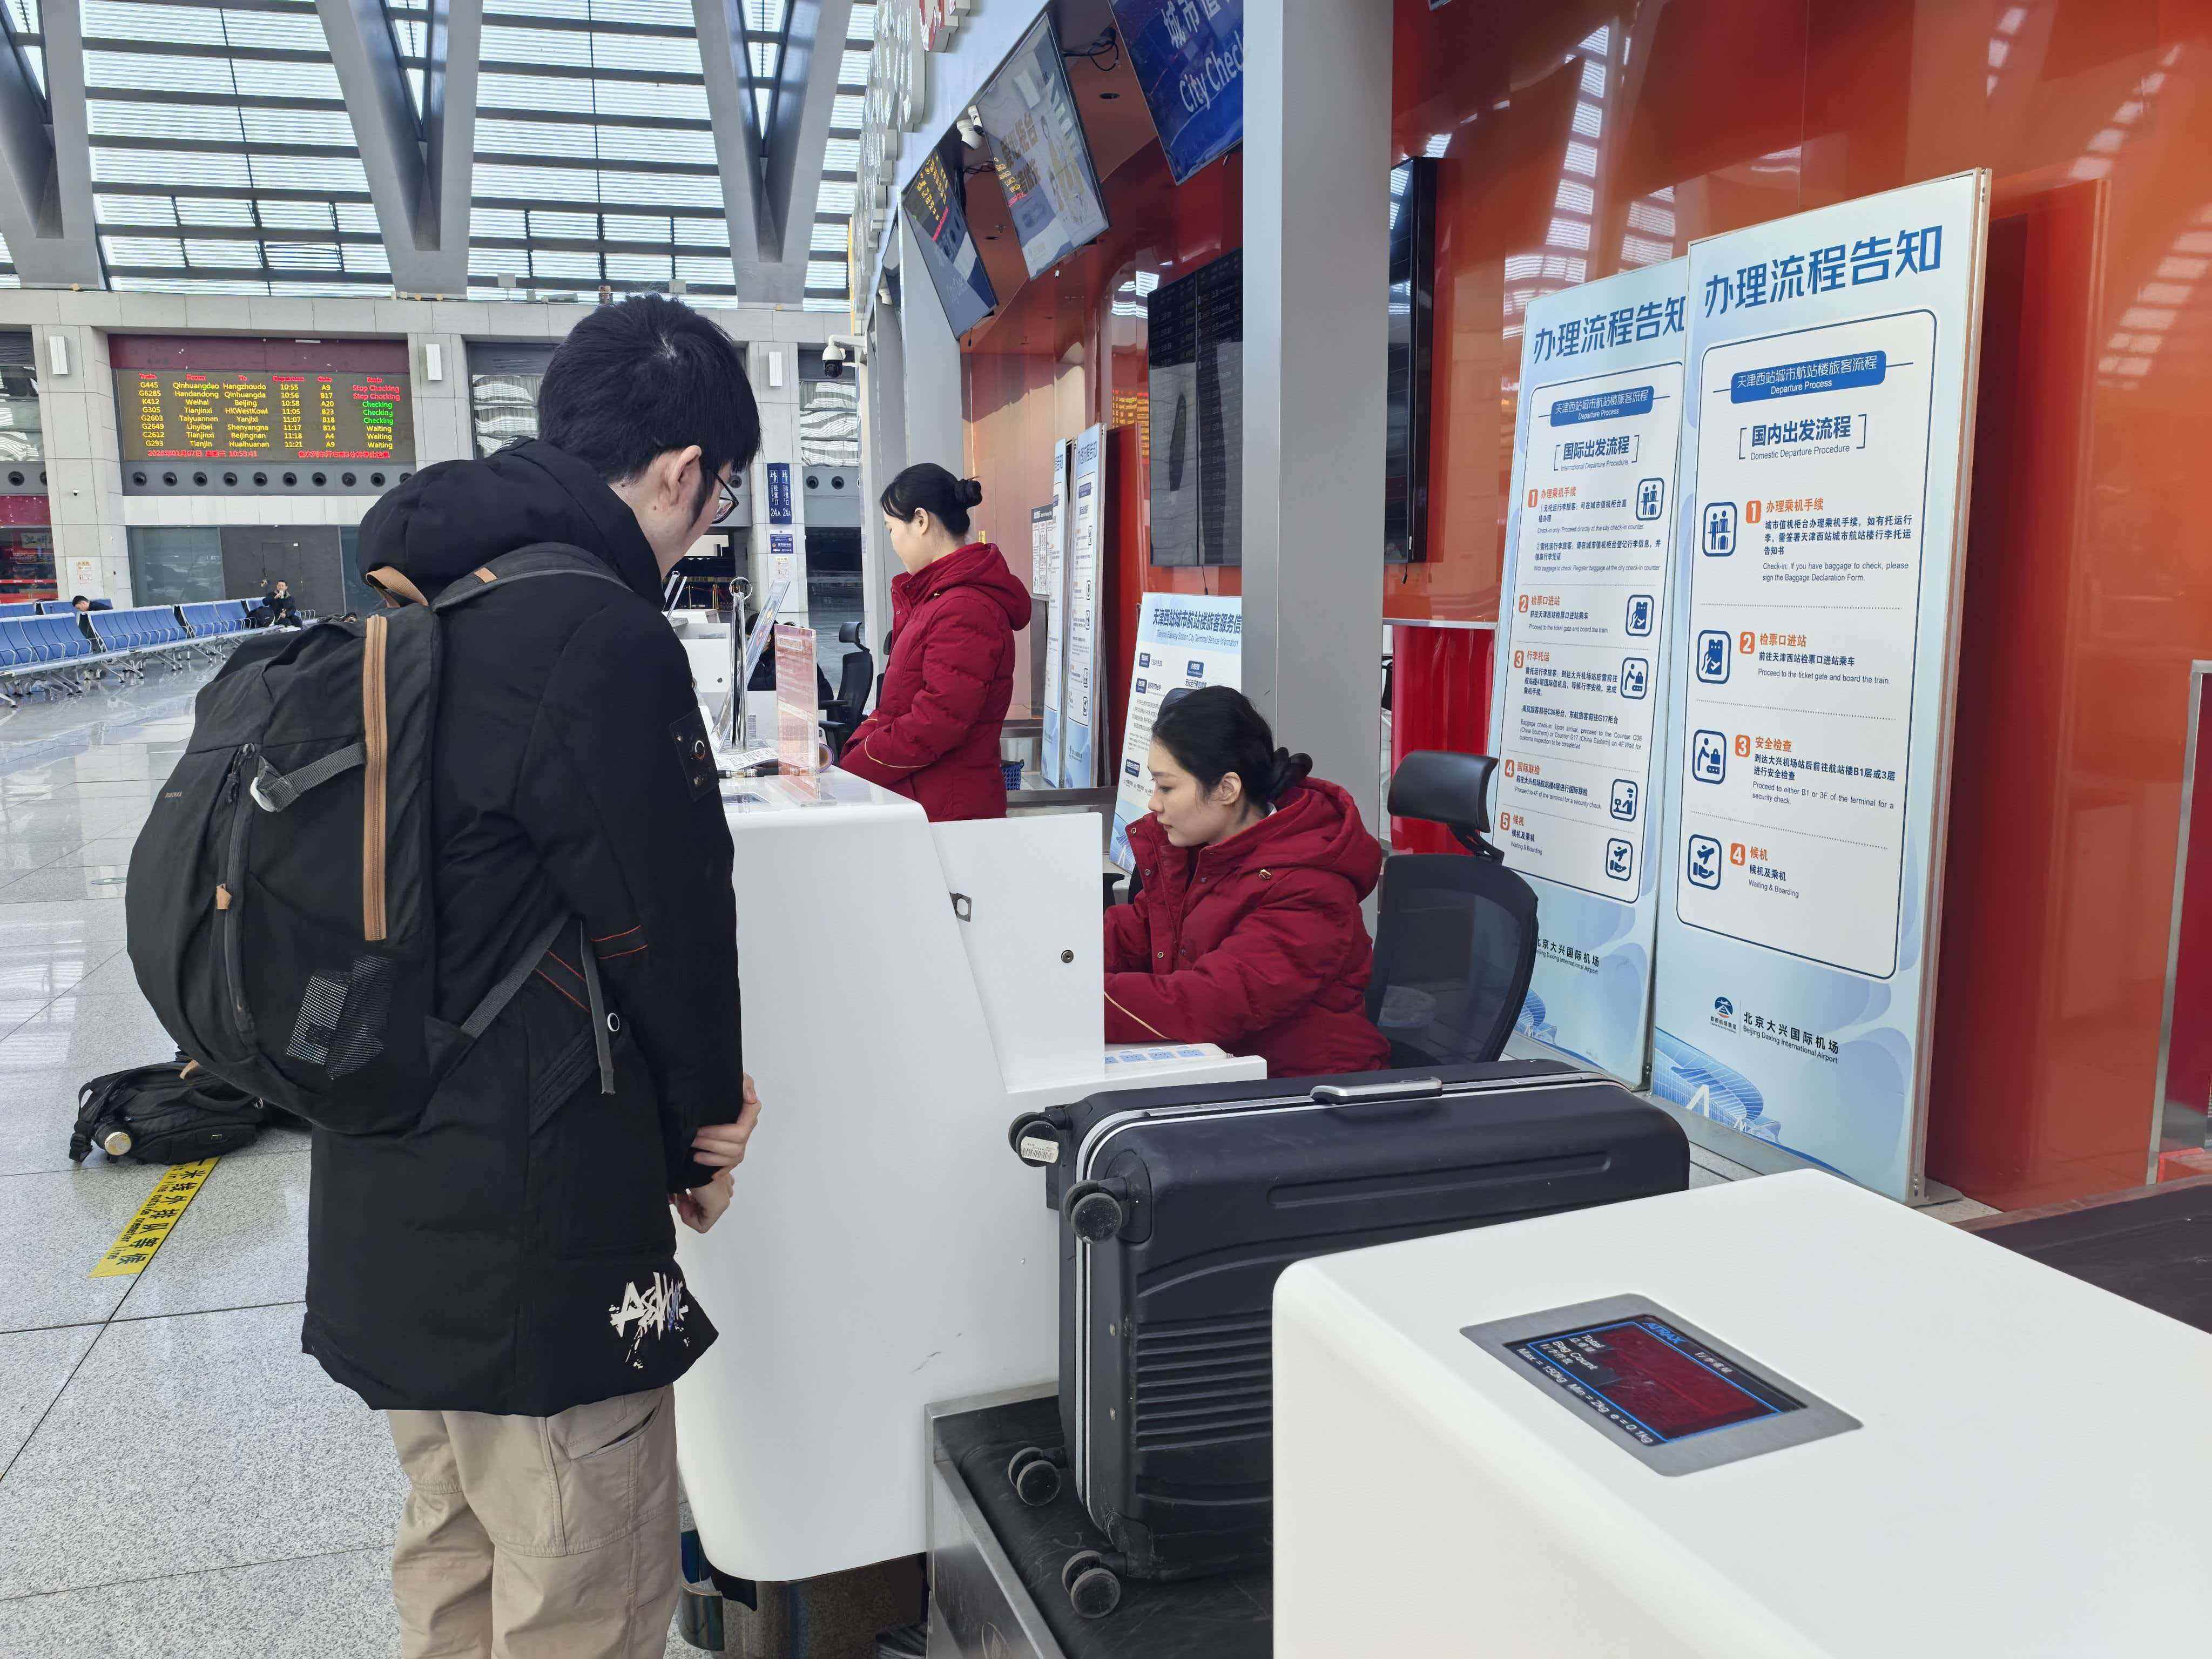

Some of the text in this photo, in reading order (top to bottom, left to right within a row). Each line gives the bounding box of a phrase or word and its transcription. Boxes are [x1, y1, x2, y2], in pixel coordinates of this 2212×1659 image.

[1179, 30, 1244, 112] City Chec
[1704, 225, 1943, 318] 办理流程告知
[1534, 296, 1686, 364] 办理流程告知
[1737, 355, 1877, 388] 天津西站城市航站楼旅客流程
[173, 382, 219, 390] Qinhuangdao
[1771, 380, 1832, 395] Departure Process
[1578, 409, 1619, 421] Departure Process
[1752, 415, 1851, 447] 国内出发流程
[1563, 436, 1630, 460] 国际出发流程
[1751, 444, 1850, 460] Domestic Departure Procedure
[1541, 487, 1577, 499] 办理乘机手续
[771, 508, 781, 517] 24A
[1766, 497, 1824, 513] 办理乘机手续
[1764, 546, 1784, 556] 告知书
[1796, 563, 1806, 571] you
[1825, 562, 1851, 571] baggage
[1886, 562, 1909, 571] please
[1785, 575, 1810, 583] Baggage
[1531, 595, 1560, 605] 检票口进站
[1153, 608, 1242, 635] 天津西站城市航站楼旅客服务信
[1743, 633, 1806, 652] 2 检票口进站
[1759, 651, 1854, 666] 前往天津西站检票口进站乘车
[1758, 668, 1780, 677] Proceed
[1798, 671, 1813, 679] ticket
[1843, 674, 1860, 683] board
[1738, 736, 1792, 755] 3 安全检查
[1517, 762, 1540, 775] 国际联检
[1754, 766, 1795, 780] 进行安全检查
[1755, 754, 1896, 781] 到达大兴机场站后前往航站楼B1层或3层
[1752, 792, 1772, 802] security
[1753, 781, 1775, 791] Proceed
[1784, 786, 1799, 795] either
[1838, 794, 1848, 802] the
[1850, 796, 1876, 807] terminal
[1878, 800, 1887, 808] for
[1732, 846, 1768, 864] 4 候机
[1750, 864, 1786, 881] 候机及乘机
[1749, 879, 1768, 891] Waiting
[1775, 886, 1799, 899] Boarding
[1744, 1011, 1838, 1055] 北京大兴国际机场
[1743, 1025, 1761, 1038] Beijing
[1762, 1031, 1780, 1046] Daxing
[1781, 1038, 1816, 1056] International
[1817, 1052, 1837, 1064] Airport
[1553, 1341, 1598, 1371] Bag Count
